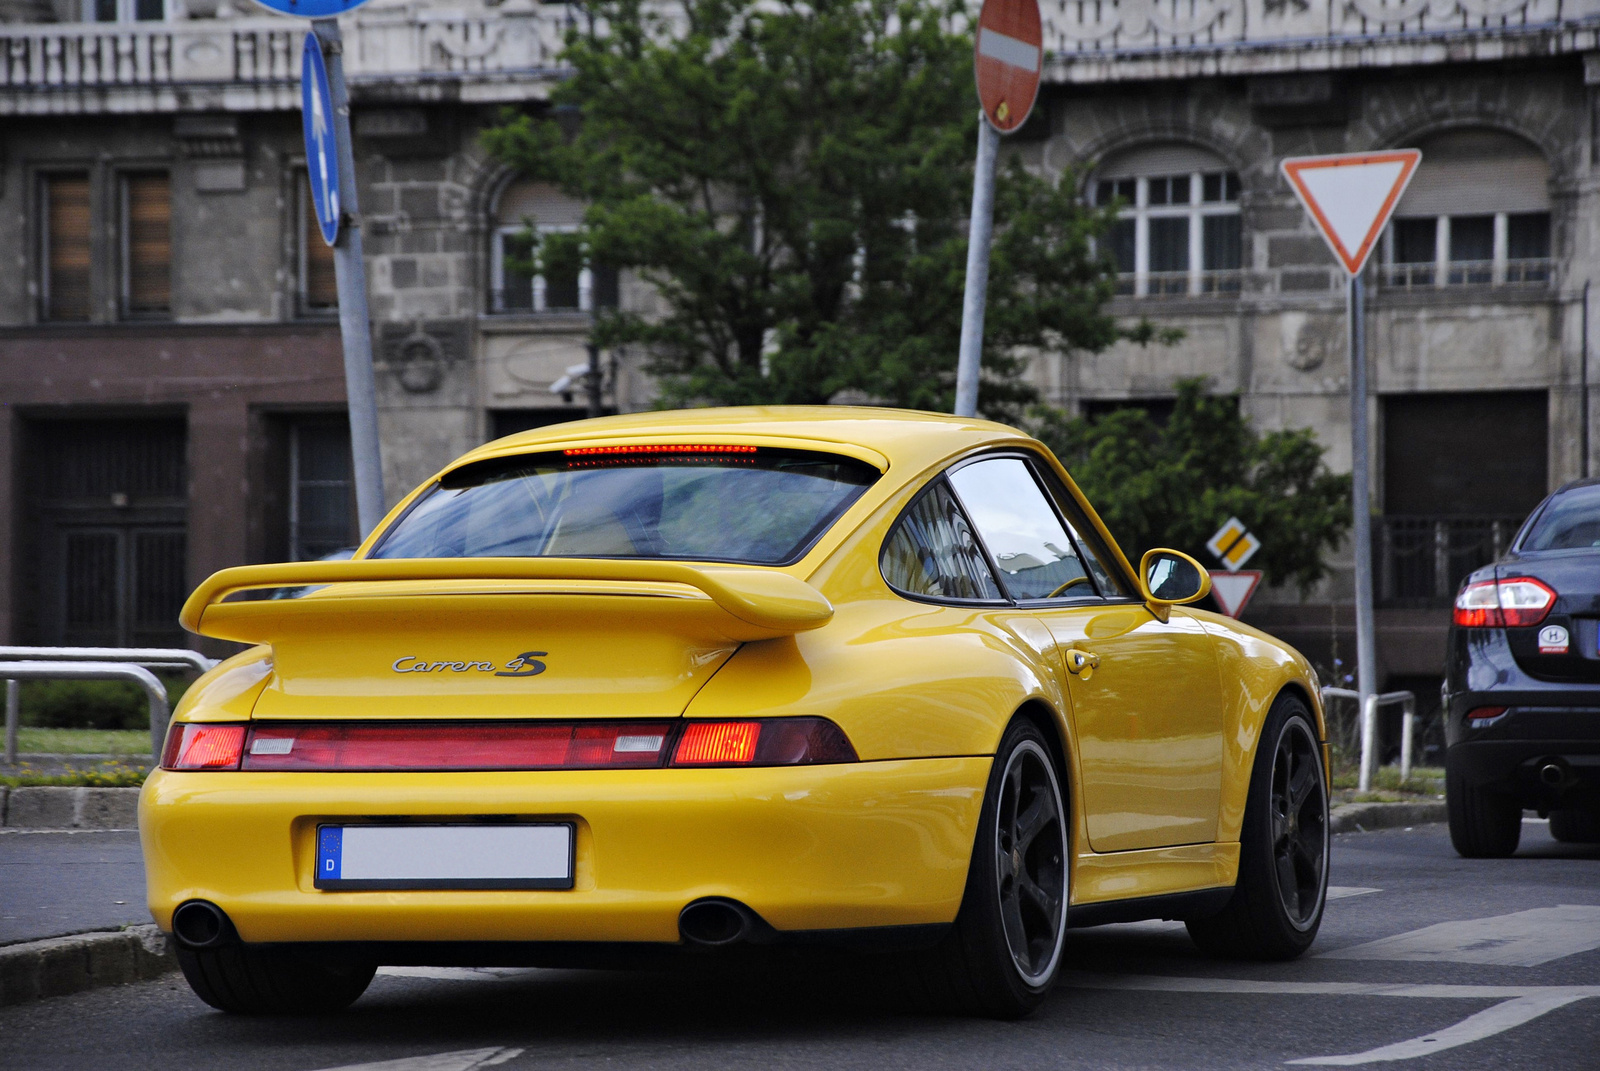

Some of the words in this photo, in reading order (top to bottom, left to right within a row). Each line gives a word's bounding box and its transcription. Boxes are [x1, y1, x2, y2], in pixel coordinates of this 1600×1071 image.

[1549, 631, 1558, 640] H
[392, 656, 496, 673] Carrera
[494, 651, 549, 677] 4S
[326, 859, 335, 871] D
